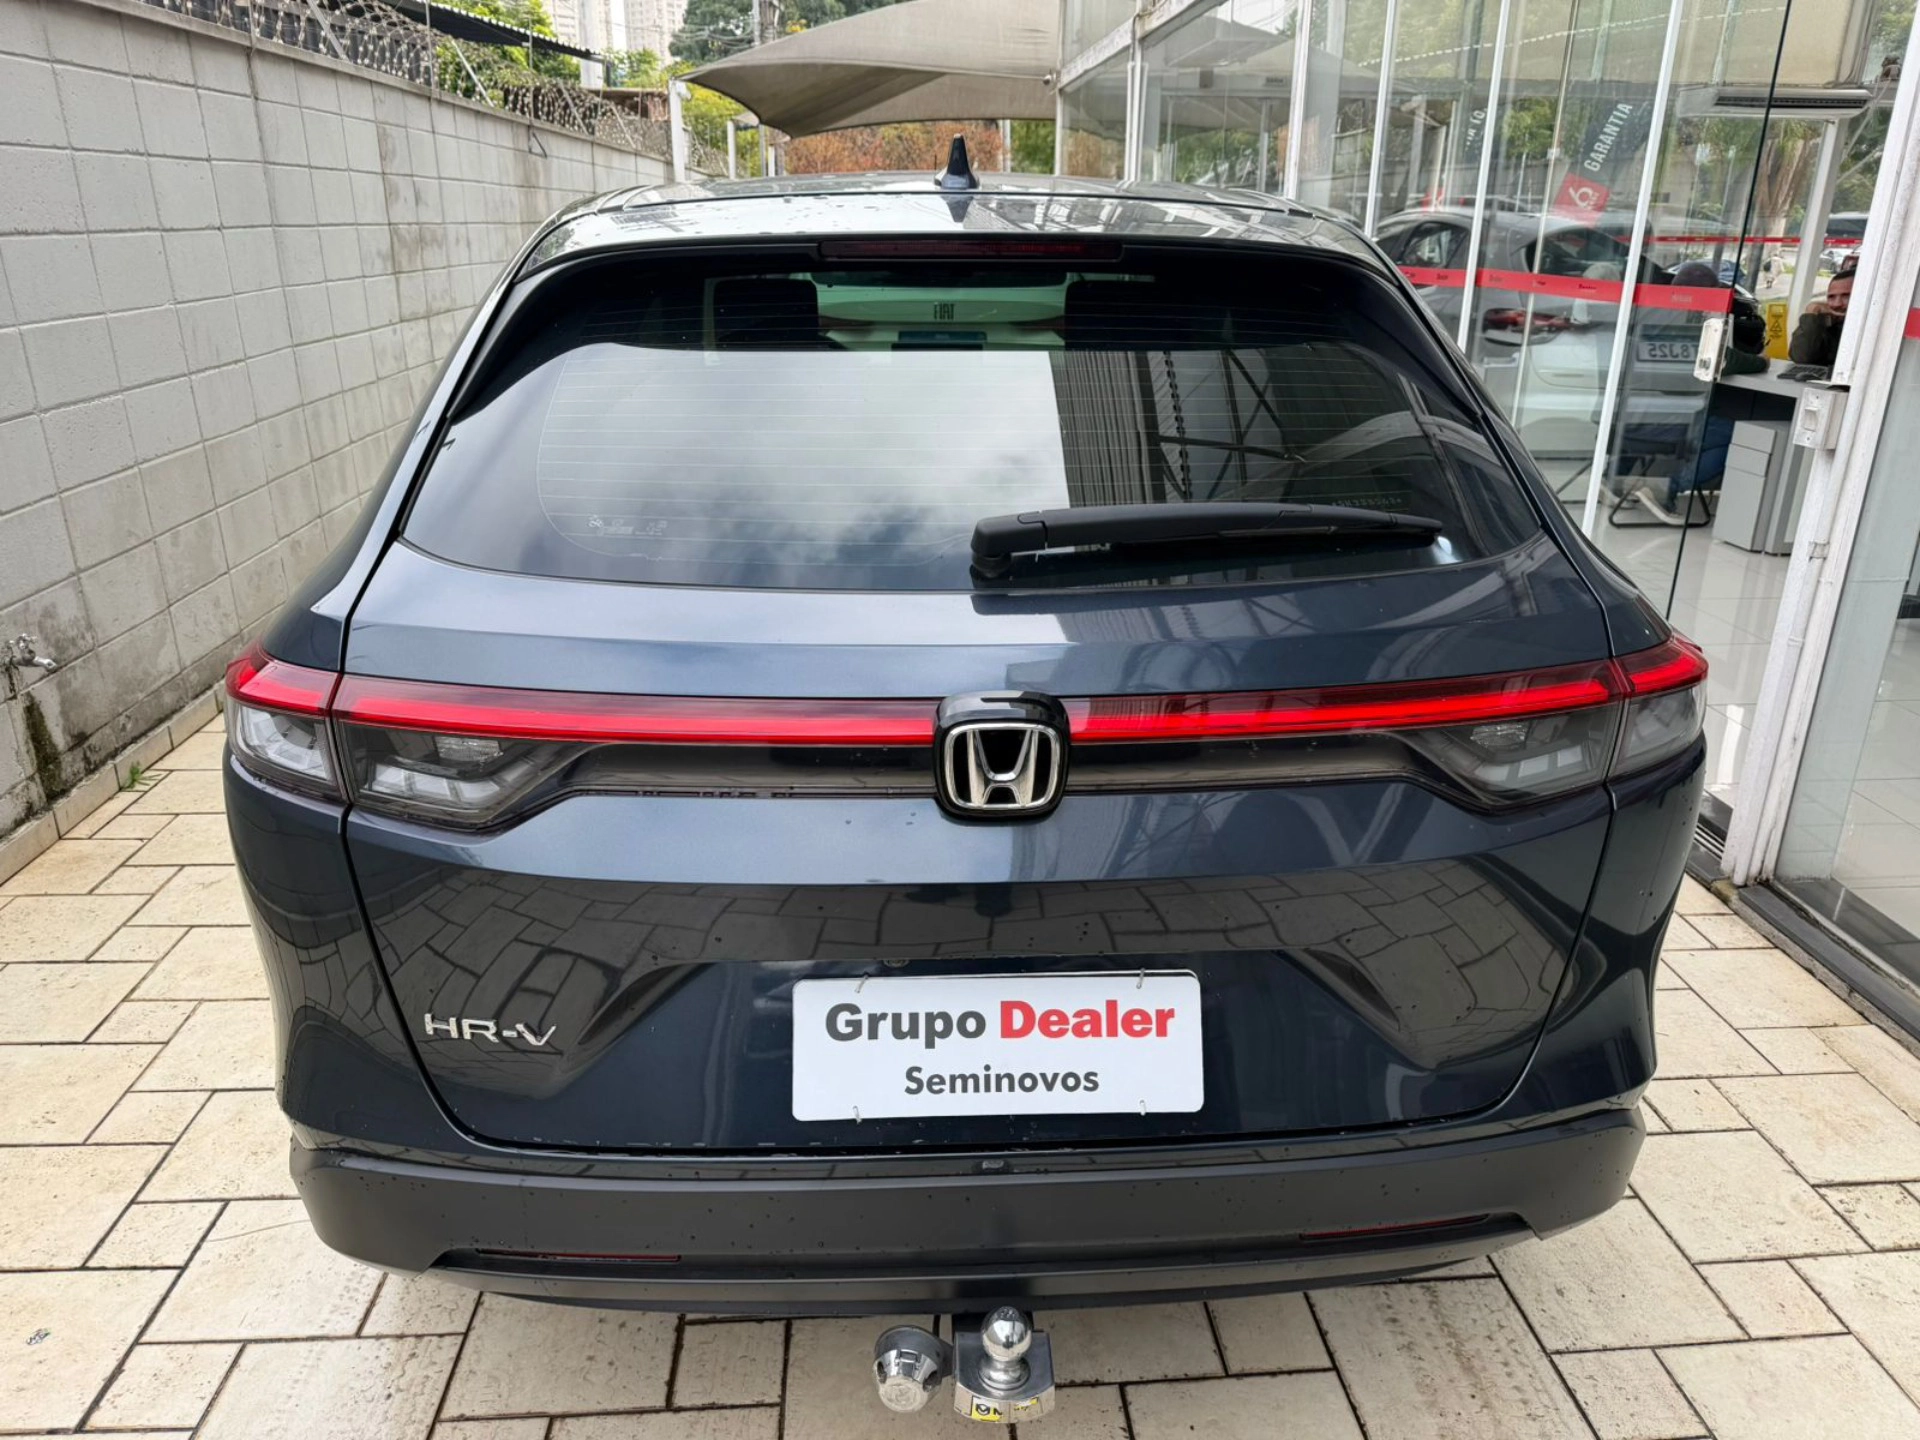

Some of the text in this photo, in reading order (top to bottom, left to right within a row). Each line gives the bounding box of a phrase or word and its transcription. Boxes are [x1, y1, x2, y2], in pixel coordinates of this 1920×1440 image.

[1584, 103, 1633, 172] GARANTIA
[933, 303, 955, 320] FIAT
[424, 1003, 557, 1046] HR-V
[825, 1000, 1175, 1049] Grupo Dealer
[904, 1064, 1100, 1095] Seminovos
